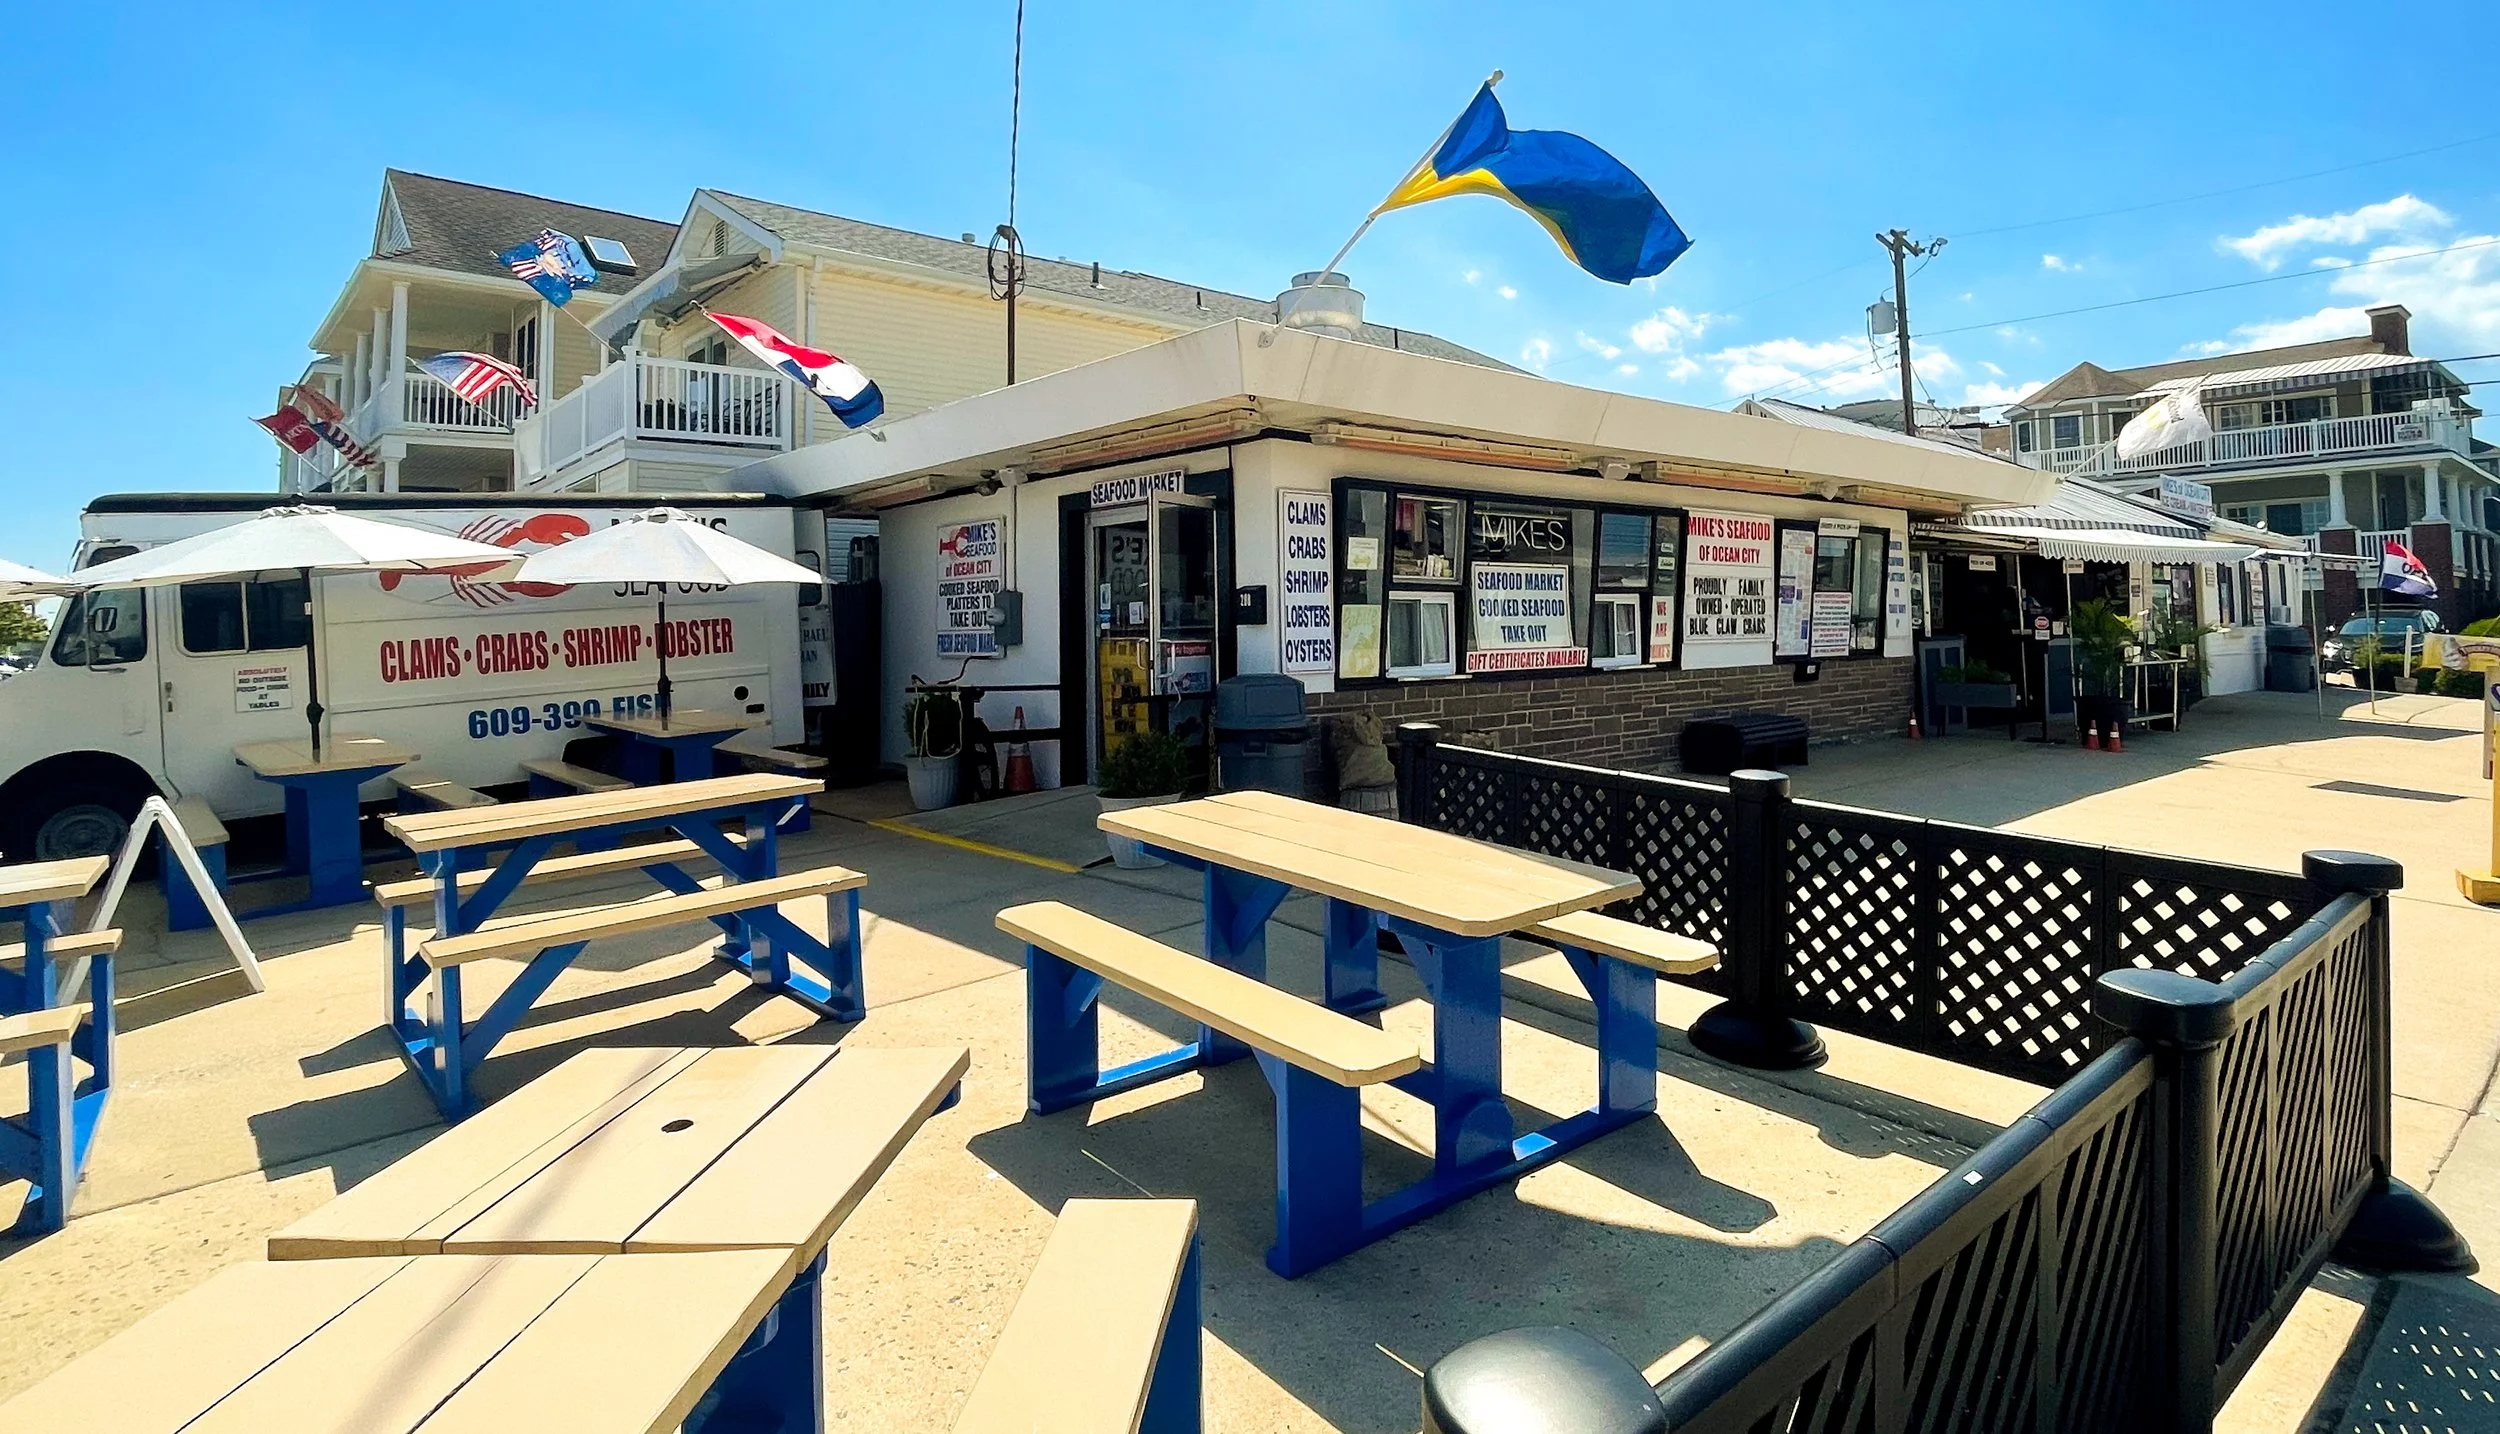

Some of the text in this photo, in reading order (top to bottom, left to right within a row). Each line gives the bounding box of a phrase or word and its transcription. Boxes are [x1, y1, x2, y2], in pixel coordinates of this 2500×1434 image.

[1093, 471, 1182, 504] SEAFOOD MARKET
[1287, 501, 1326, 526] CLAMS
[967, 522, 996, 543] MIKE'S
[1481, 514, 1566, 551] MIKES
[1687, 516, 1724, 538] MIKE'S
[1726, 519, 1771, 541] SEAFOOD
[966, 542, 997, 558] SEAFOOD
[1288, 535, 1326, 560] CRABS
[1699, 545, 1760, 564] OF OCEAN CITY
[953, 561, 975, 577] OCEAN
[976, 560, 992, 574] CITY
[939, 579, 999, 597] COOKED SEAFOOD
[1286, 570, 1329, 594] SHRIMP
[1477, 571, 1564, 591] SEAFOOD MARKET
[1693, 577, 1765, 596] PROUDLY FAMILY
[946, 595, 991, 611] PLATTERS TO
[1479, 598, 1565, 617] COOKED SEAFOOD
[1695, 597, 1766, 615] OWNED OPERATED
[949, 611, 988, 628] TAKE OUT
[1286, 604, 1330, 628] LOBSTERS
[1501, 624, 1547, 643] TAKE OUT
[1689, 618, 1766, 636] BLUE CLAW CRABS
[380, 636, 461, 683] CLAMS
[475, 630, 549, 675] CRABS
[563, 624, 642, 668] SHRIMP
[1285, 639, 1332, 663] OYSTERS
[1468, 649, 1586, 671] GIFT CERTIFICATES AVAILABLE
[237, 667, 287, 676] ABSOLUTELY
[468, 698, 601, 739] 609-390
